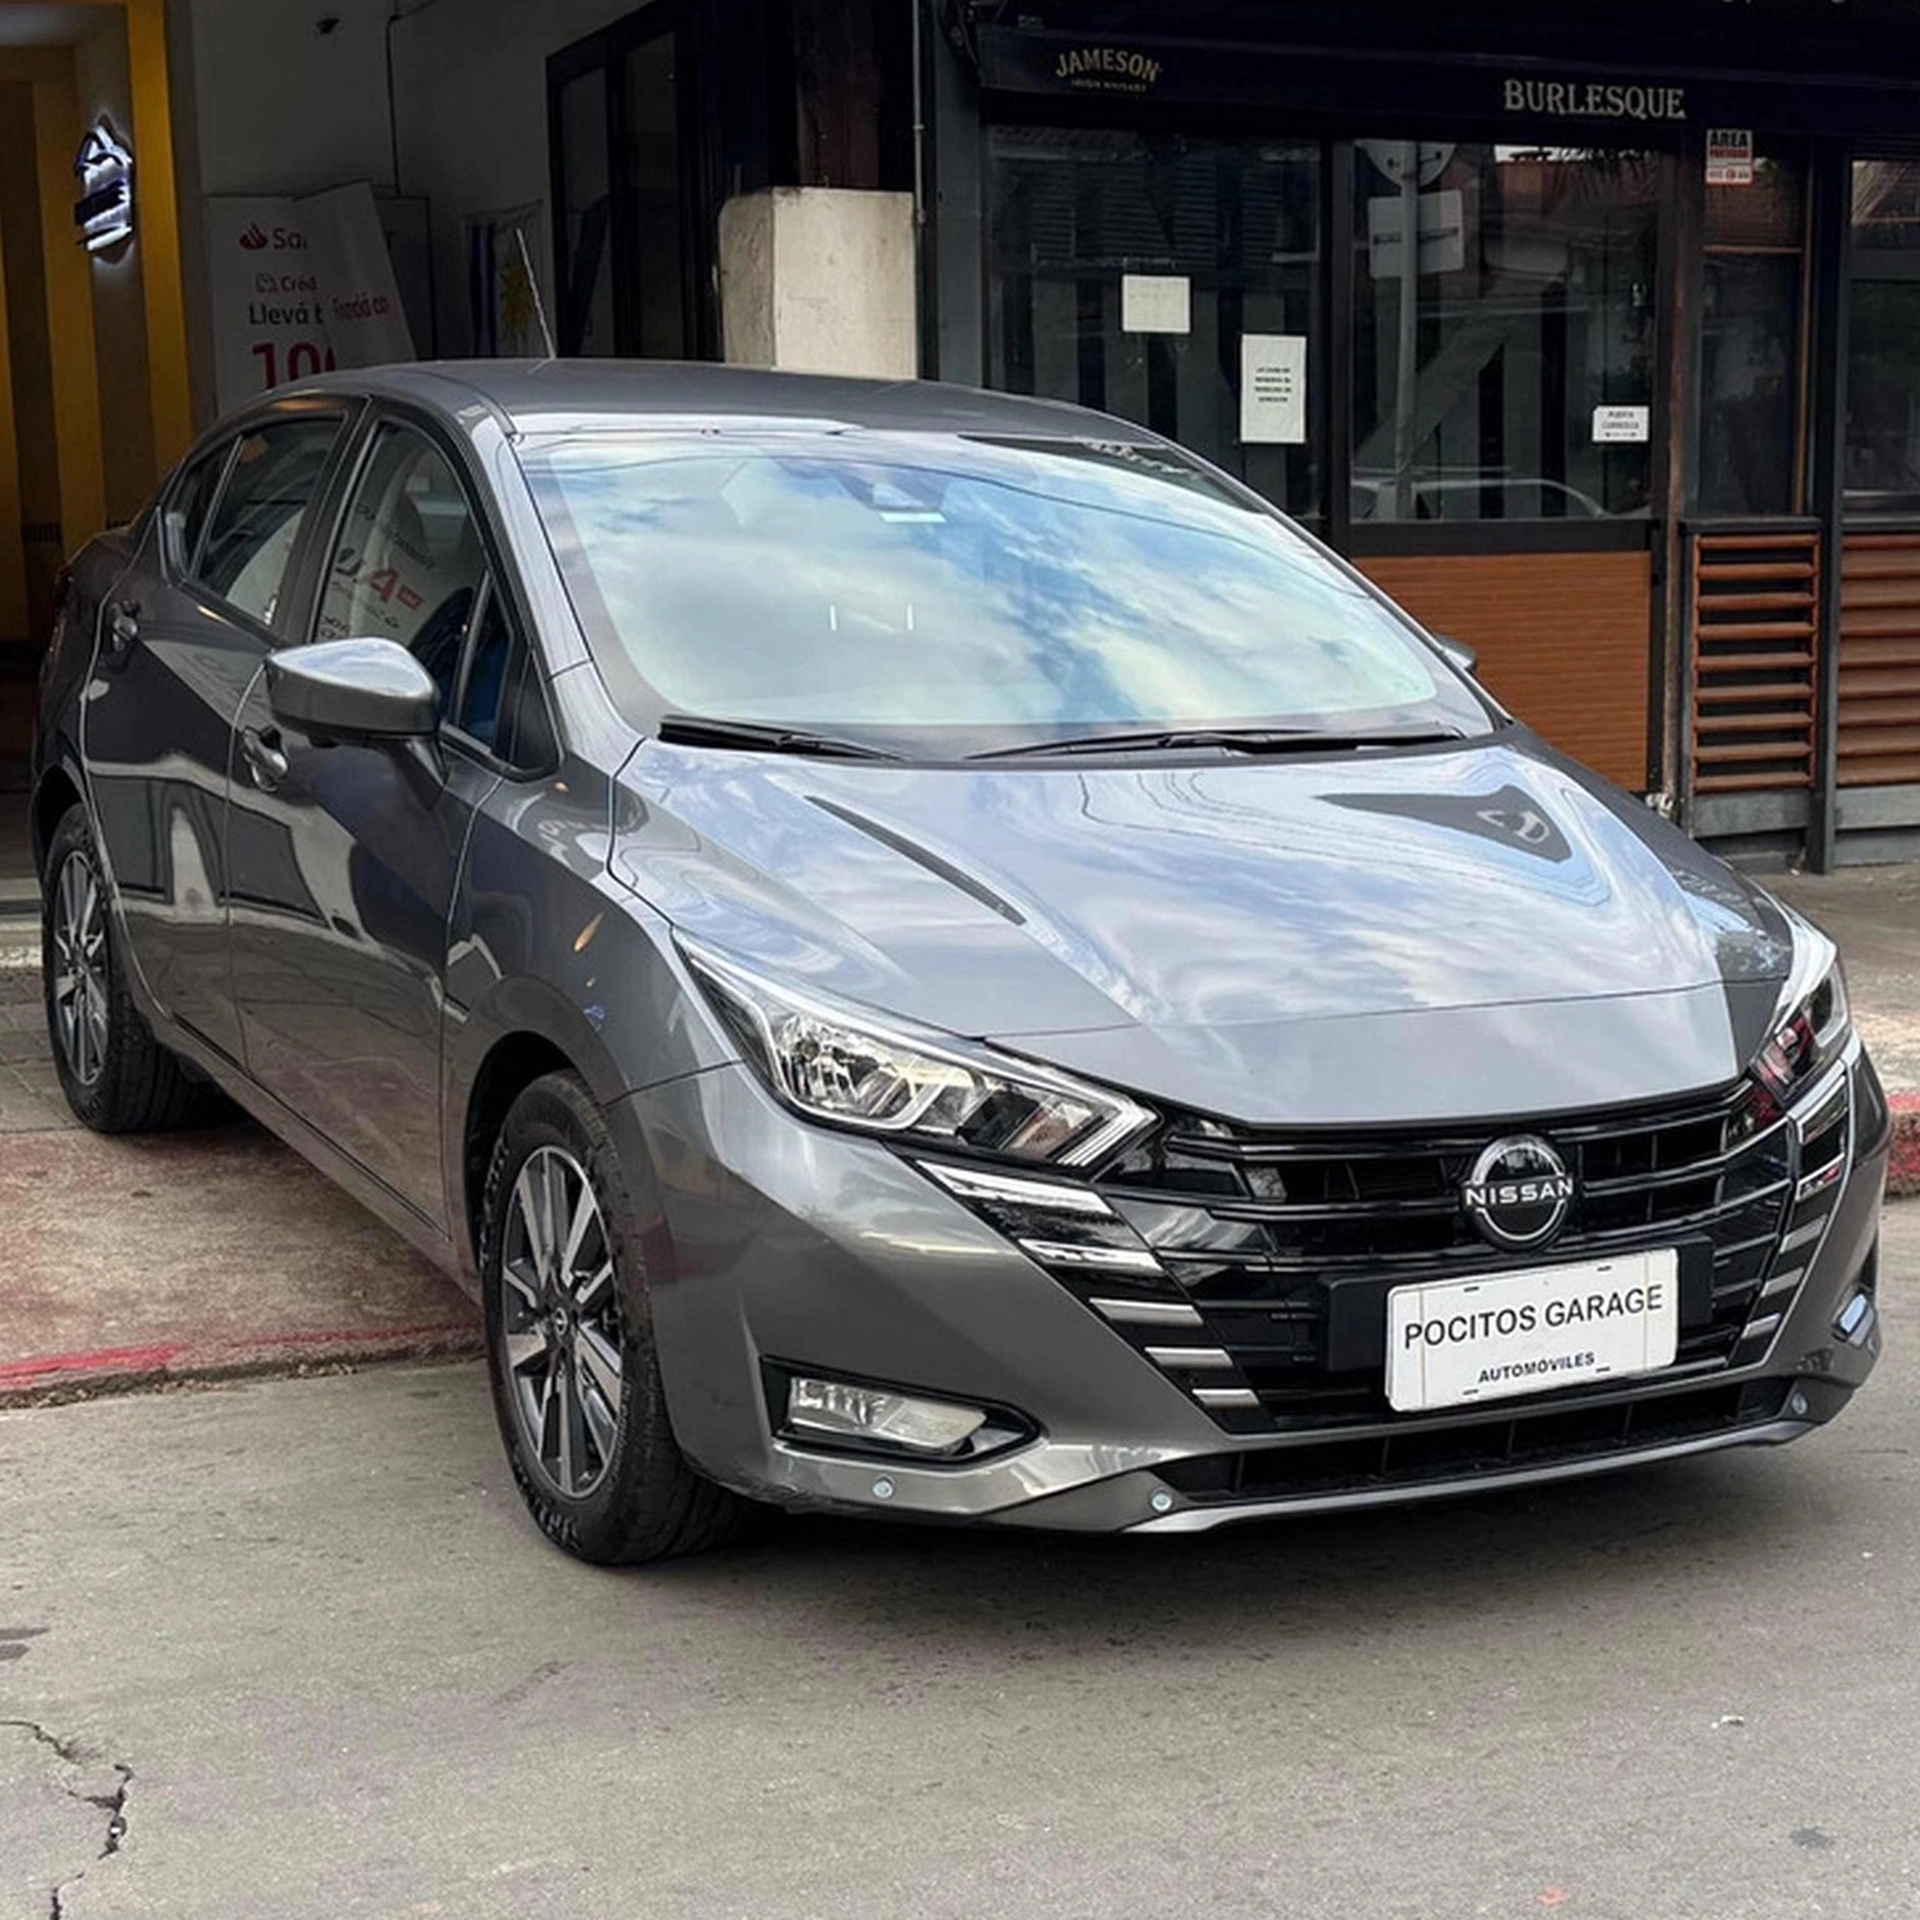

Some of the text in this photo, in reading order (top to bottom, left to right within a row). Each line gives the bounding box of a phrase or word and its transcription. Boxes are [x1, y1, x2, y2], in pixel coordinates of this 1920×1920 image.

[1056, 49, 1159, 82] JAMESON
[1504, 79, 1687, 119] BURLESQUE
[273, 228, 307, 250] Sa
[249, 302, 310, 325] Llevá
[1466, 1178, 1574, 1205] NISSAN
[1405, 1284, 1663, 1350] POCITOS GARAGE
[1478, 1352, 1596, 1384] AUTOMOVILES
